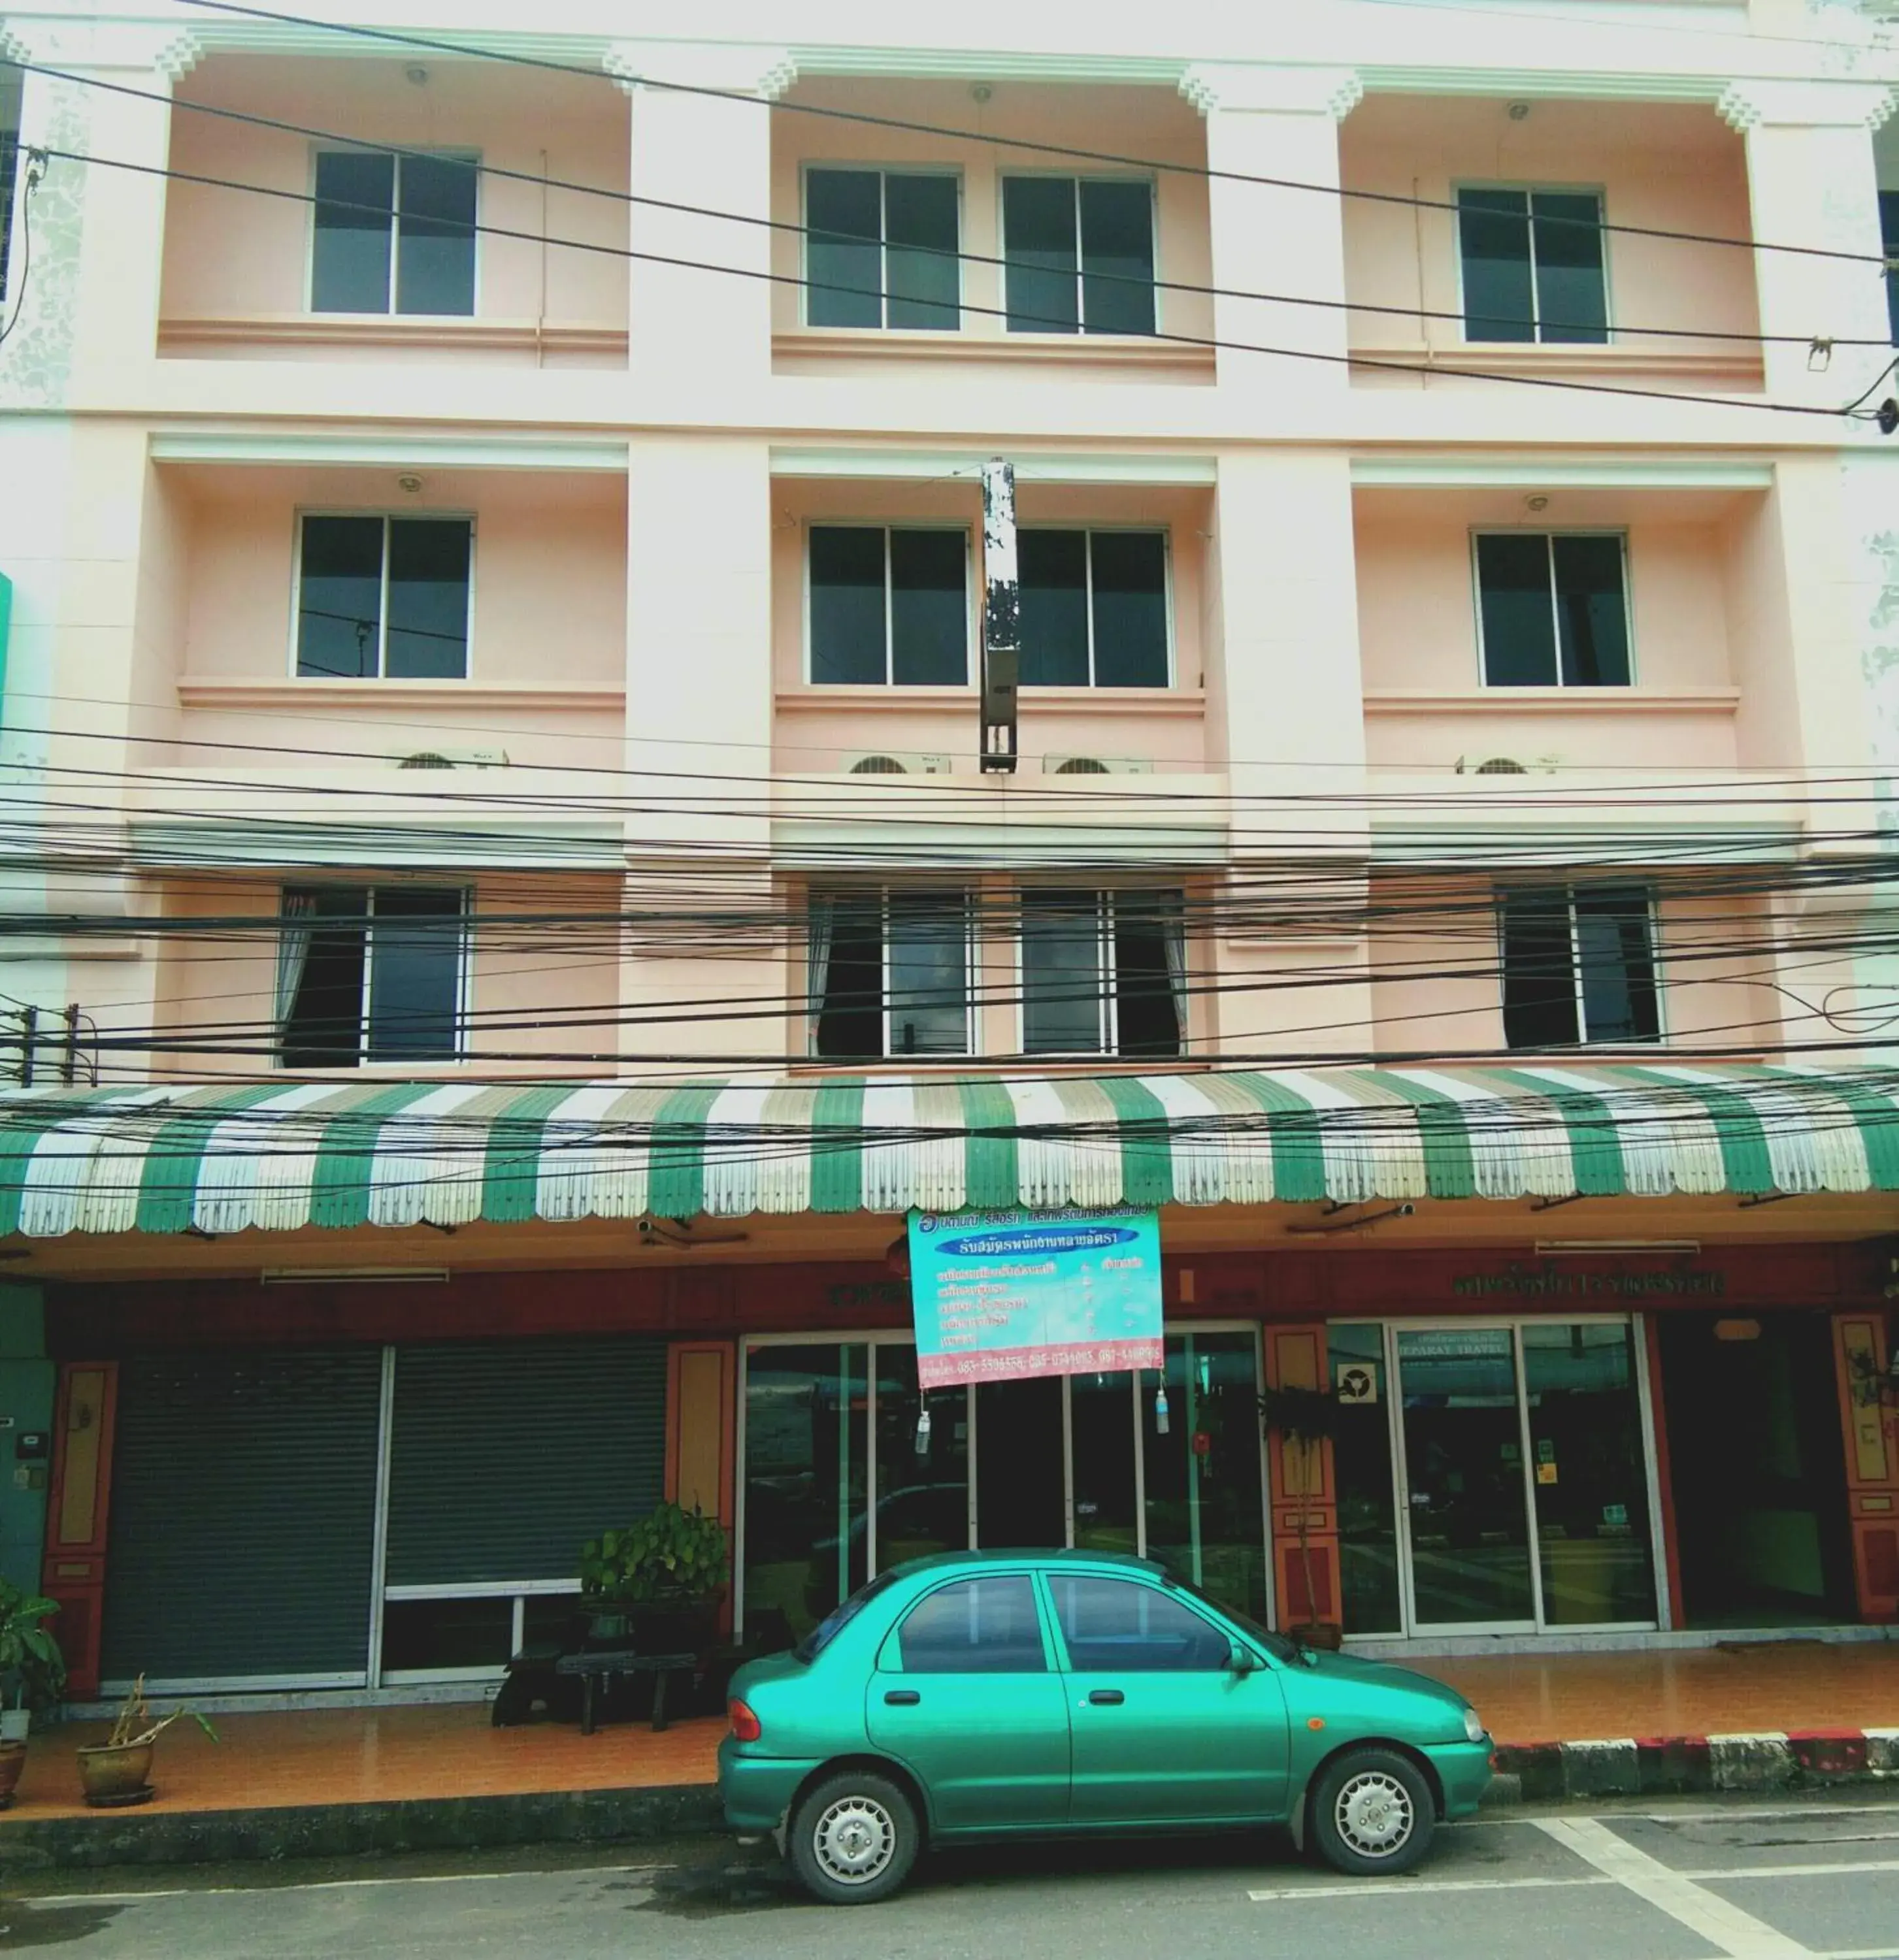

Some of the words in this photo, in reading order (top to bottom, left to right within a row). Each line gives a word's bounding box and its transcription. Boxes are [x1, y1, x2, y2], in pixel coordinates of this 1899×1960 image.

[959, 1229, 1118, 1254] รับสมัครพนักงานหลายอัตรา
[1457, 1343, 1505, 1354] TRAVEL
